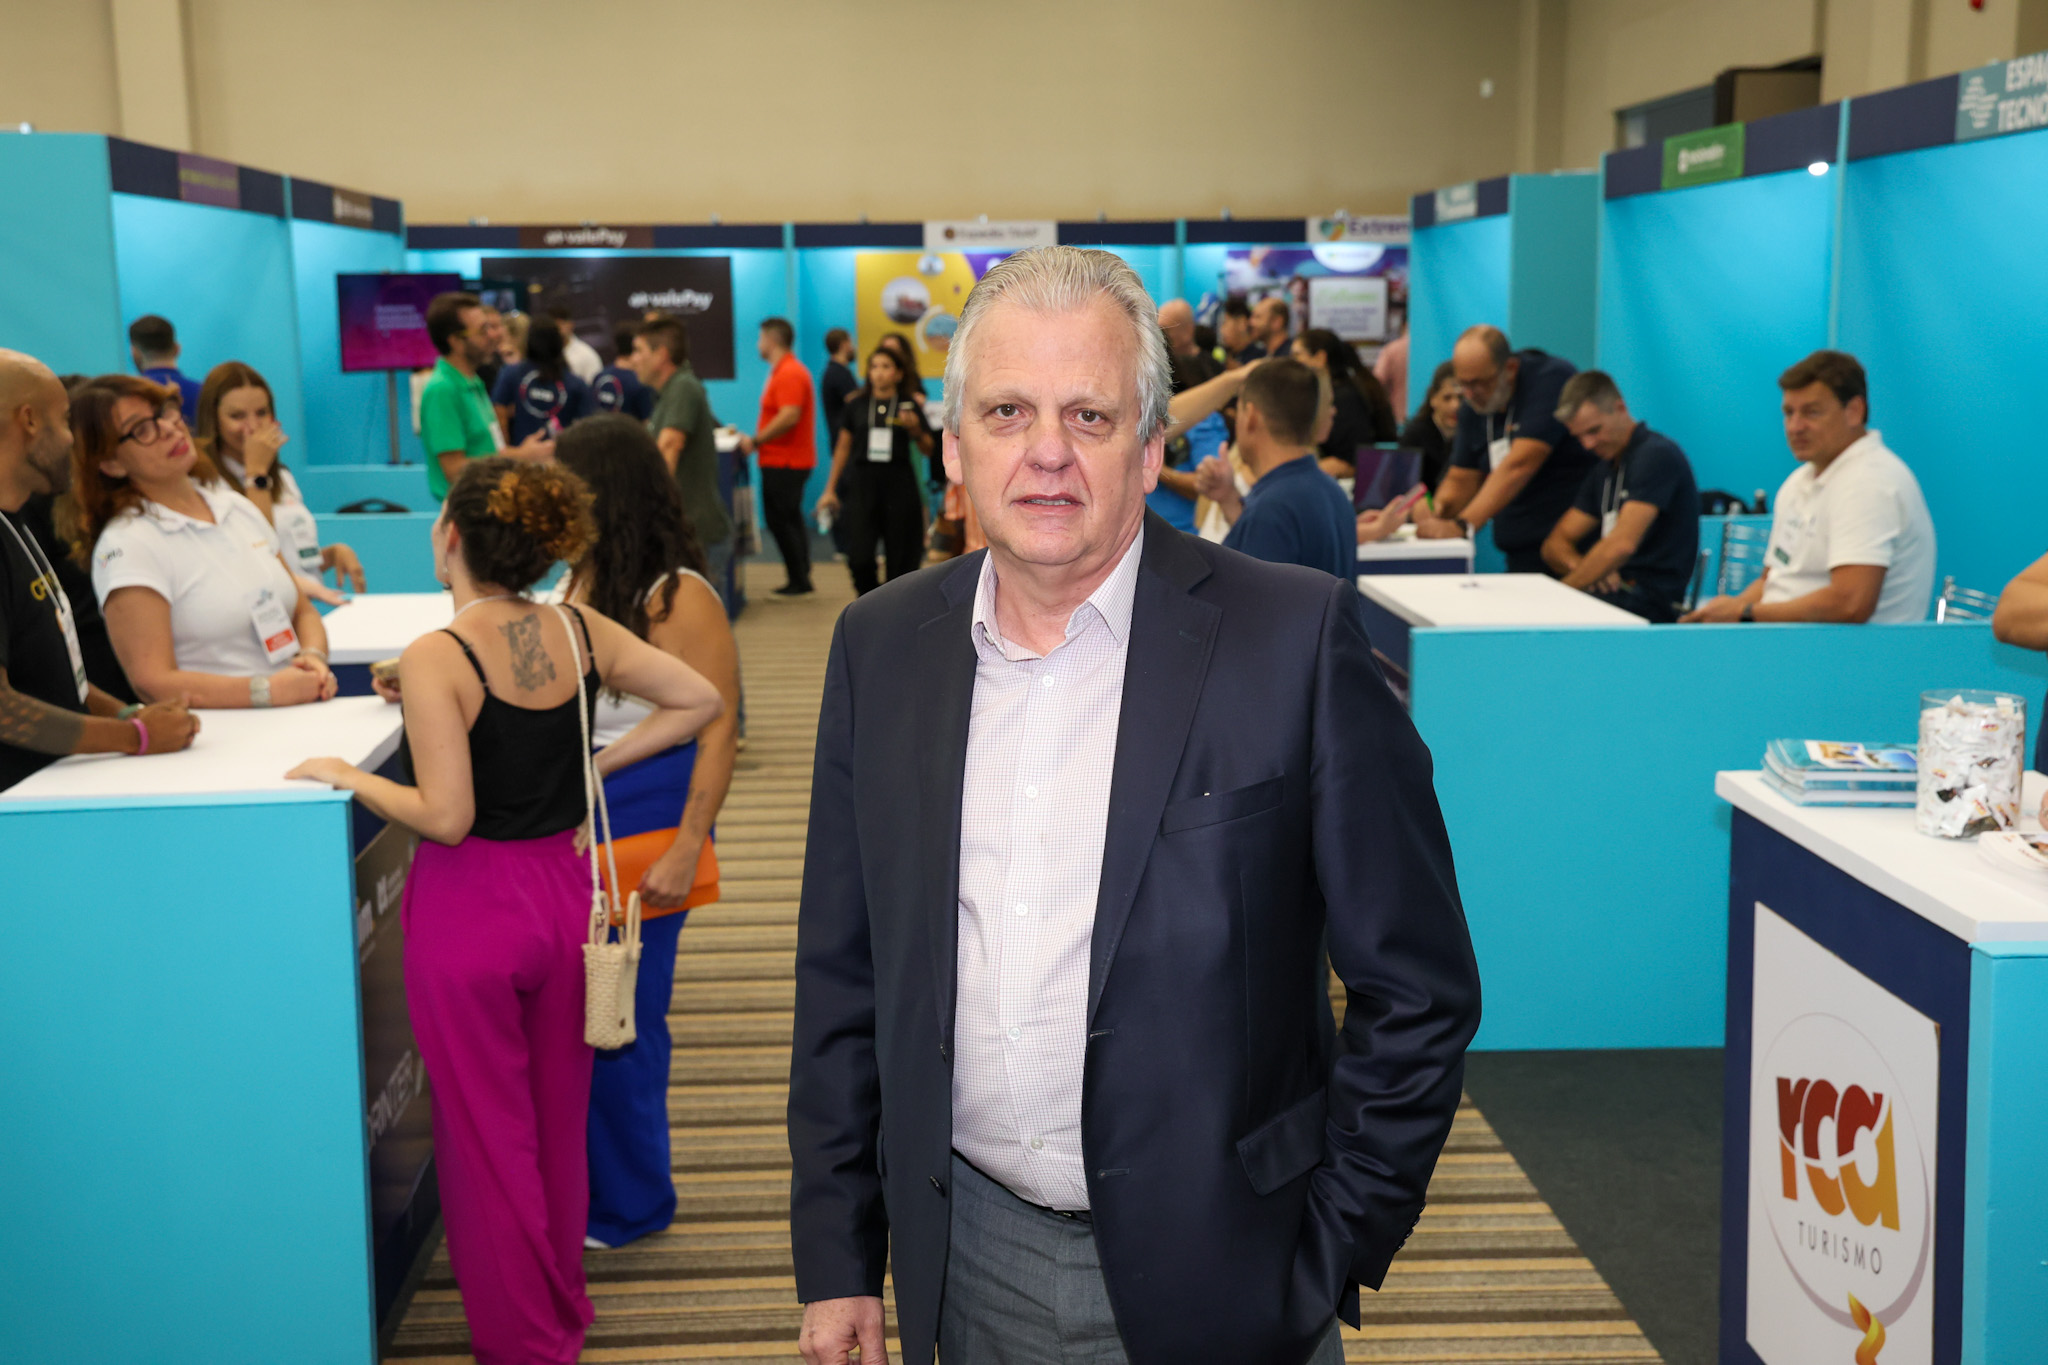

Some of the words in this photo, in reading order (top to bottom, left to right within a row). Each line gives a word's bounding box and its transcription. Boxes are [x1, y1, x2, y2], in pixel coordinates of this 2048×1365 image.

[2006, 51, 2048, 92] ESPA
[1776, 1076, 1901, 1232] rca
[1798, 1220, 1883, 1275] TURISMO
